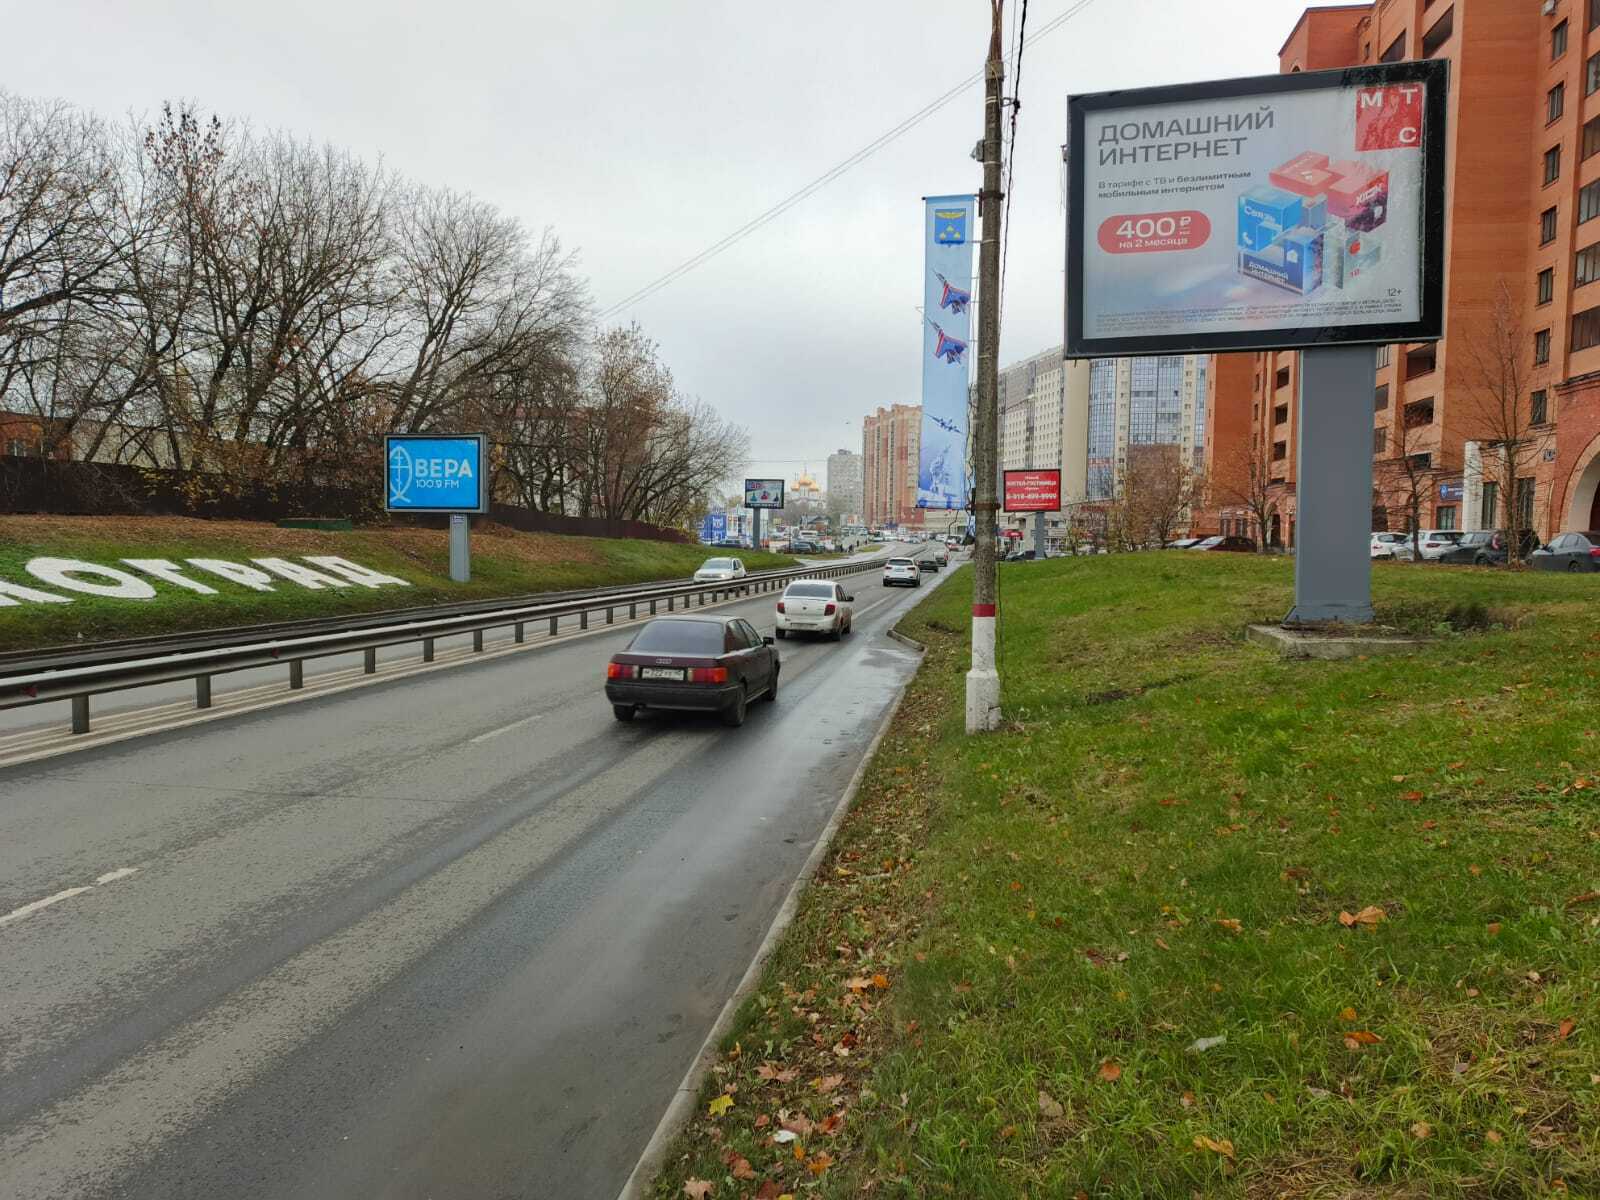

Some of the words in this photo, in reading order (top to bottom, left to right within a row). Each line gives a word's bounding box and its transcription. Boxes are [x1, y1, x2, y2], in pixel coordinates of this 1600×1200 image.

[1098, 105, 1274, 146] ДОМАШНИЙ
[1099, 137, 1248, 166] ИНТЕРНЕТ
[1098, 181, 1106, 189] В
[1108, 177, 1144, 190] тарифе
[1153, 177, 1167, 185] ТВ
[1176, 171, 1252, 183] безлимитным
[1098, 187, 1159, 199] мобильным
[1160, 183, 1225, 195] интернетом
[1116, 217, 1176, 239] 400
[1119, 240, 1133, 249] на
[1135, 239, 1144, 248] 2
[1144, 237, 1189, 248] месяца
[1387, 288, 1402, 297] 12+
[415, 458, 472, 478] ВЕРА
[444, 479, 460, 489] FM
